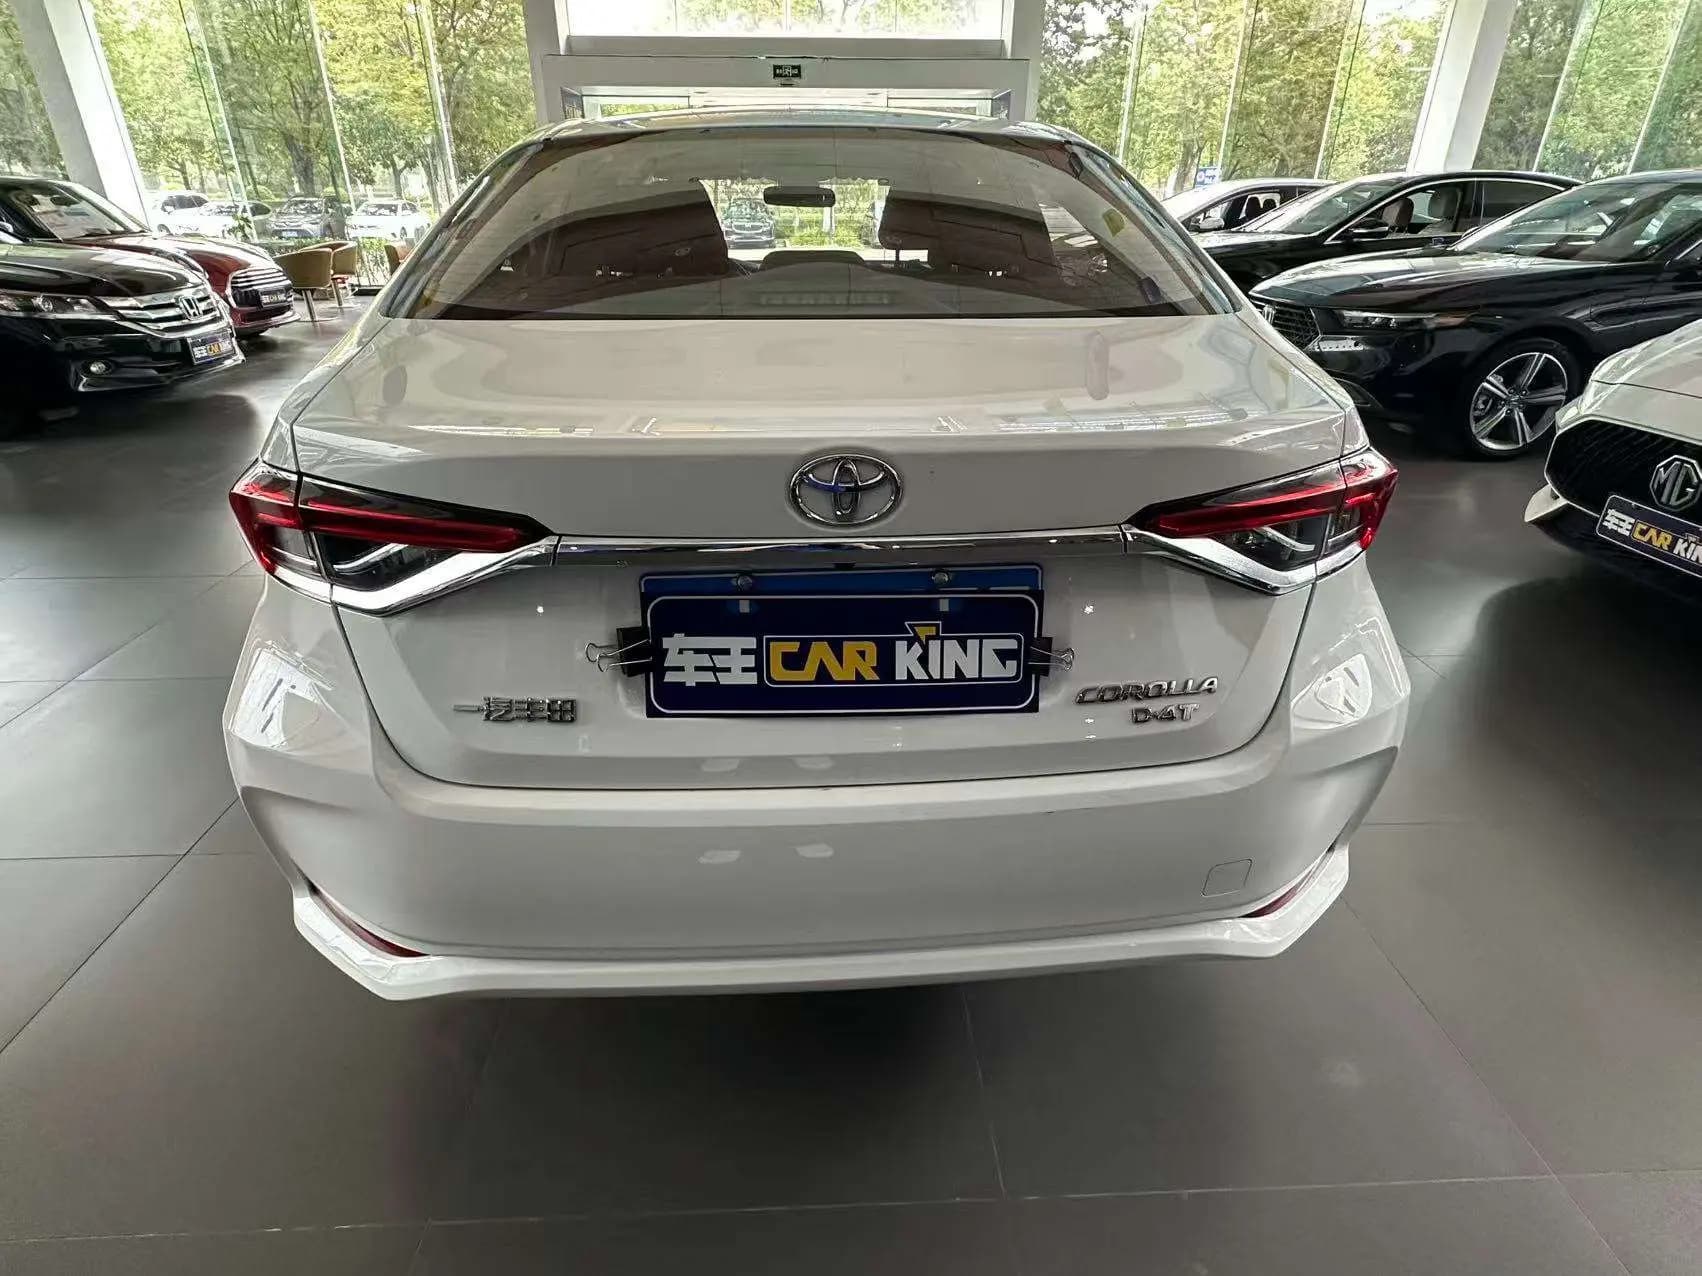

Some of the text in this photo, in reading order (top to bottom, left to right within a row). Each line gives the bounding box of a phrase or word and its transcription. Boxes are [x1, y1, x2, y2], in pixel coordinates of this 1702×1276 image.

[1653, 461, 1699, 506] MG
[1633, 522, 1702, 564] CAR KIN
[662, 633, 758, 686] 车王
[769, 628, 1018, 681] CAR KING
[453, 696, 577, 722] 一汽丰田
[1075, 676, 1218, 704] COROLLA
[1131, 703, 1199, 724] D-4T
